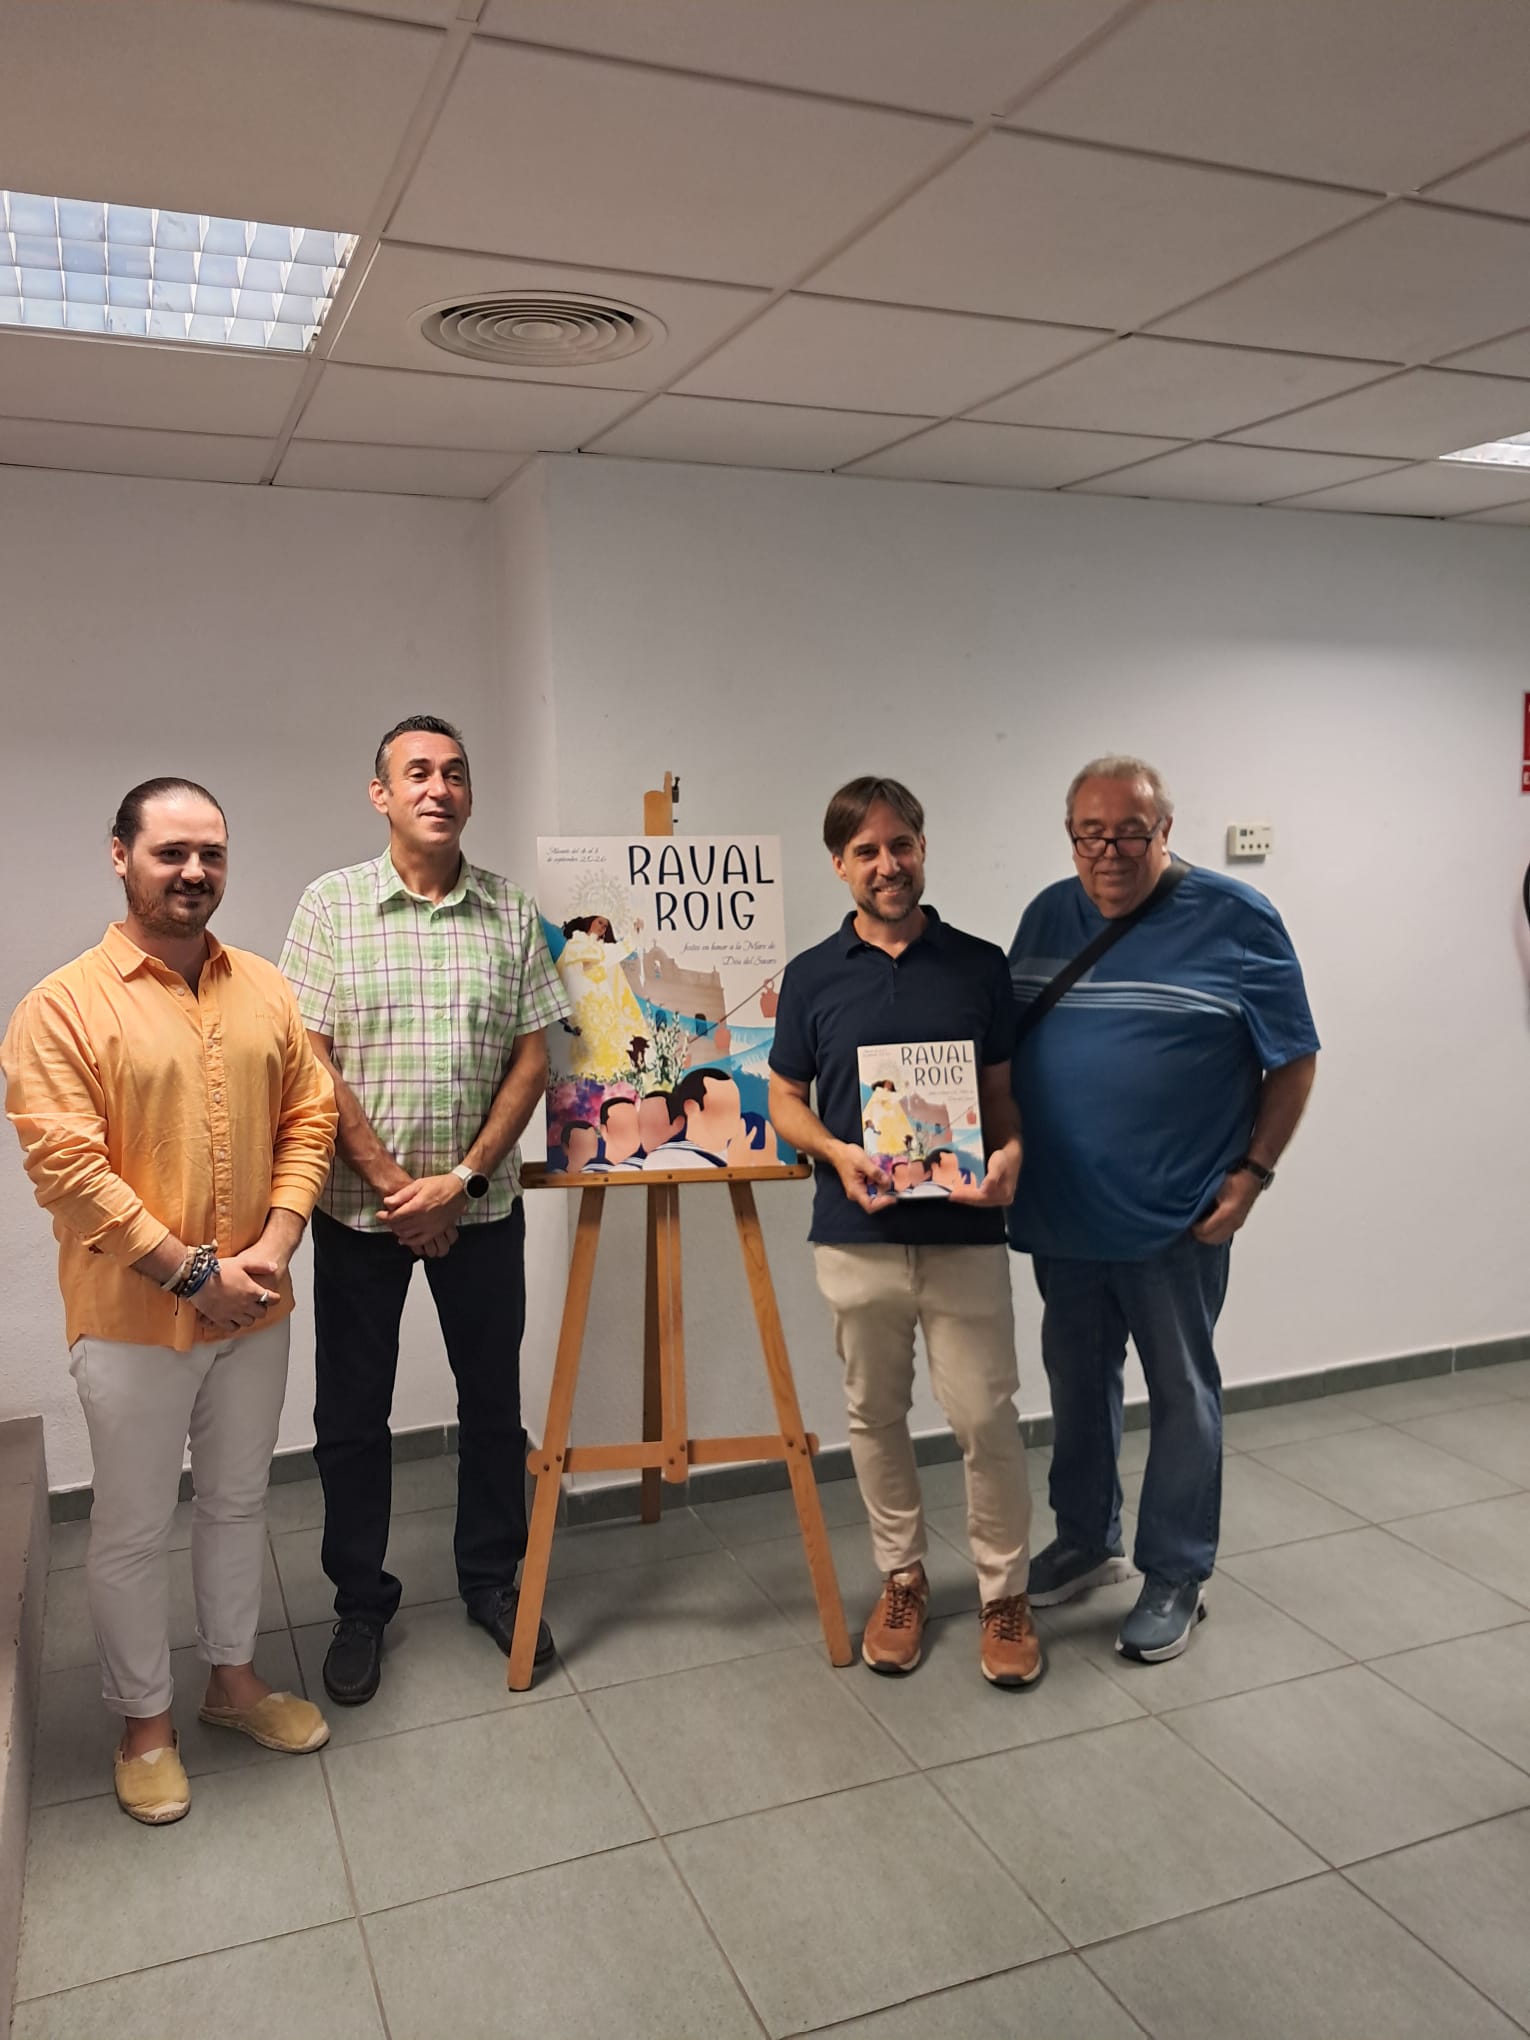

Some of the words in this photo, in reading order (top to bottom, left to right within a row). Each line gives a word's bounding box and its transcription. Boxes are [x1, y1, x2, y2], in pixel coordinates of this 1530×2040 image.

[628, 844, 774, 885] RAVAL
[655, 890, 755, 931] ROIG
[901, 1044, 973, 1065] RAVAL
[914, 1065, 963, 1086] ROIG
